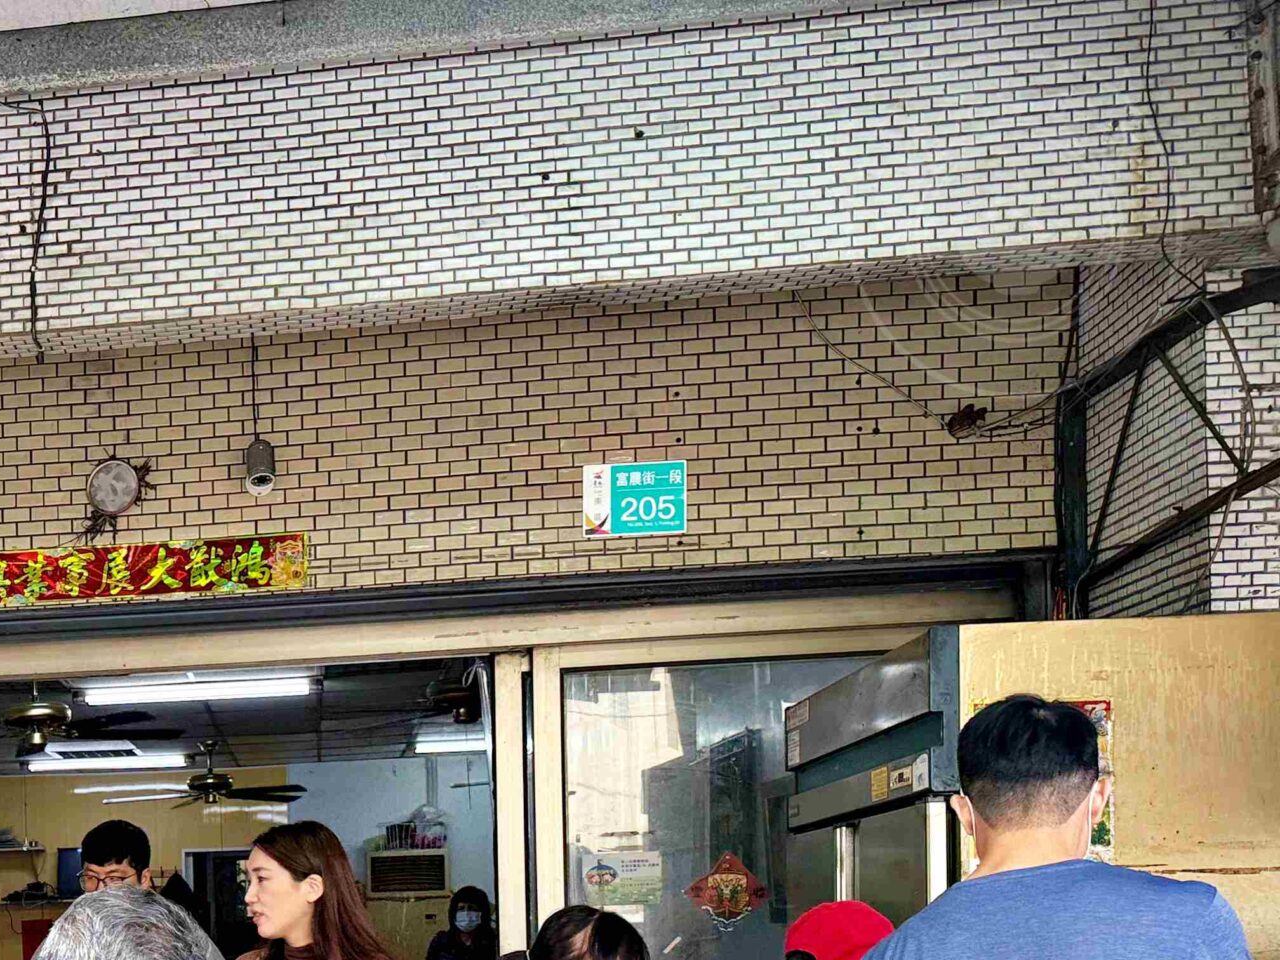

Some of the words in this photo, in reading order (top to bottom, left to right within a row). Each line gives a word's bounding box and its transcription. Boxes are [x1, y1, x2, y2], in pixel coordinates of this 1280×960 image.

[616, 469, 682, 487] 富農街一段
[621, 495, 676, 521] 205
